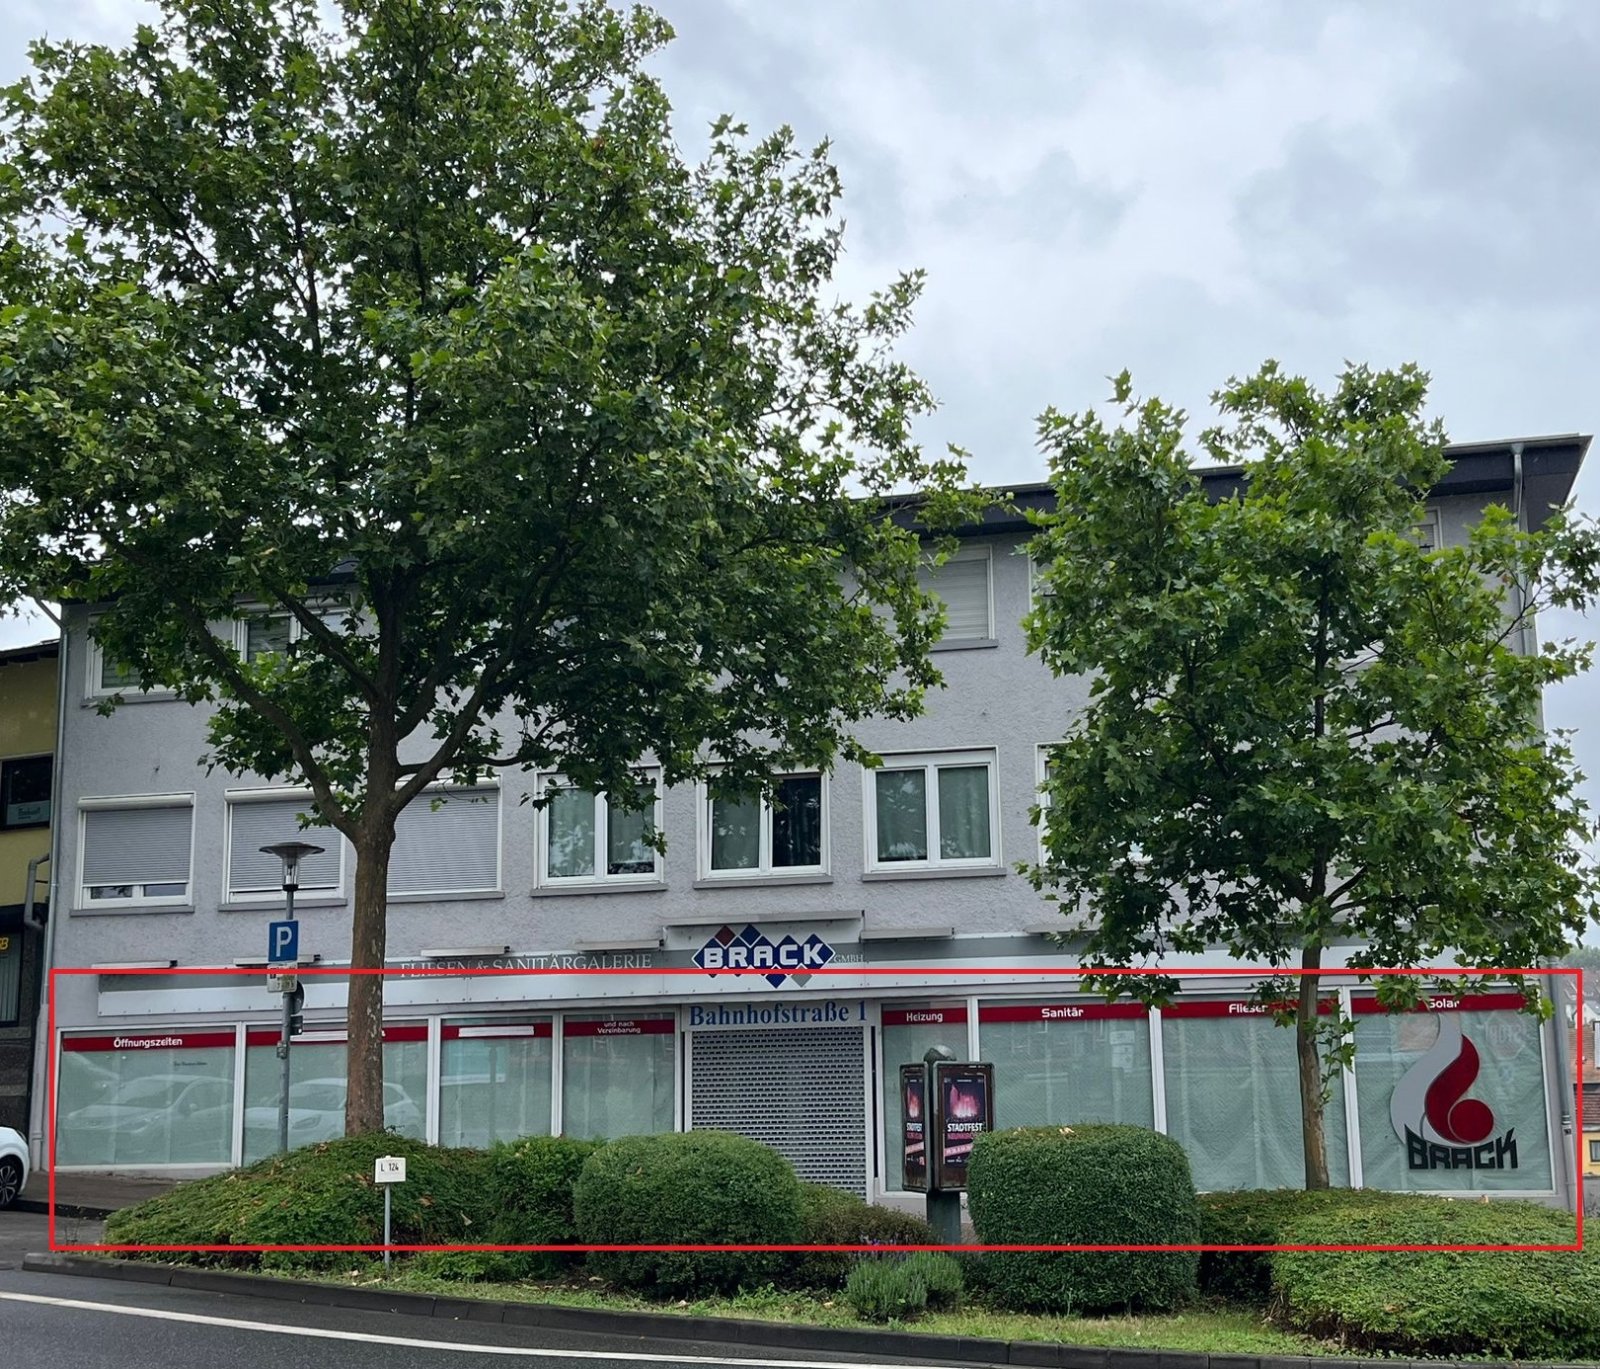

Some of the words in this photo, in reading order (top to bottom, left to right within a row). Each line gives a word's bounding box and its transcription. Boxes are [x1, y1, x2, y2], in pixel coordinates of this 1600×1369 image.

[275, 926, 293, 957] P
[703, 943, 824, 968] BRACK
[492, 953, 652, 974] SANITÄRGALERIE
[1429, 998, 1460, 1009] Solar
[690, 1002, 849, 1026] Bahnhofstraße
[858, 1001, 867, 1021] 1
[906, 1012, 943, 1023] Heizung
[1041, 1007, 1084, 1018] Sanitär
[113, 1037, 183, 1049] Öffnungszeiten
[947, 1122, 983, 1133] STADTFEST
[1404, 1124, 1518, 1169] BRACK
[380, 1163, 385, 1172] L
[388, 1162, 399, 1171] 124
